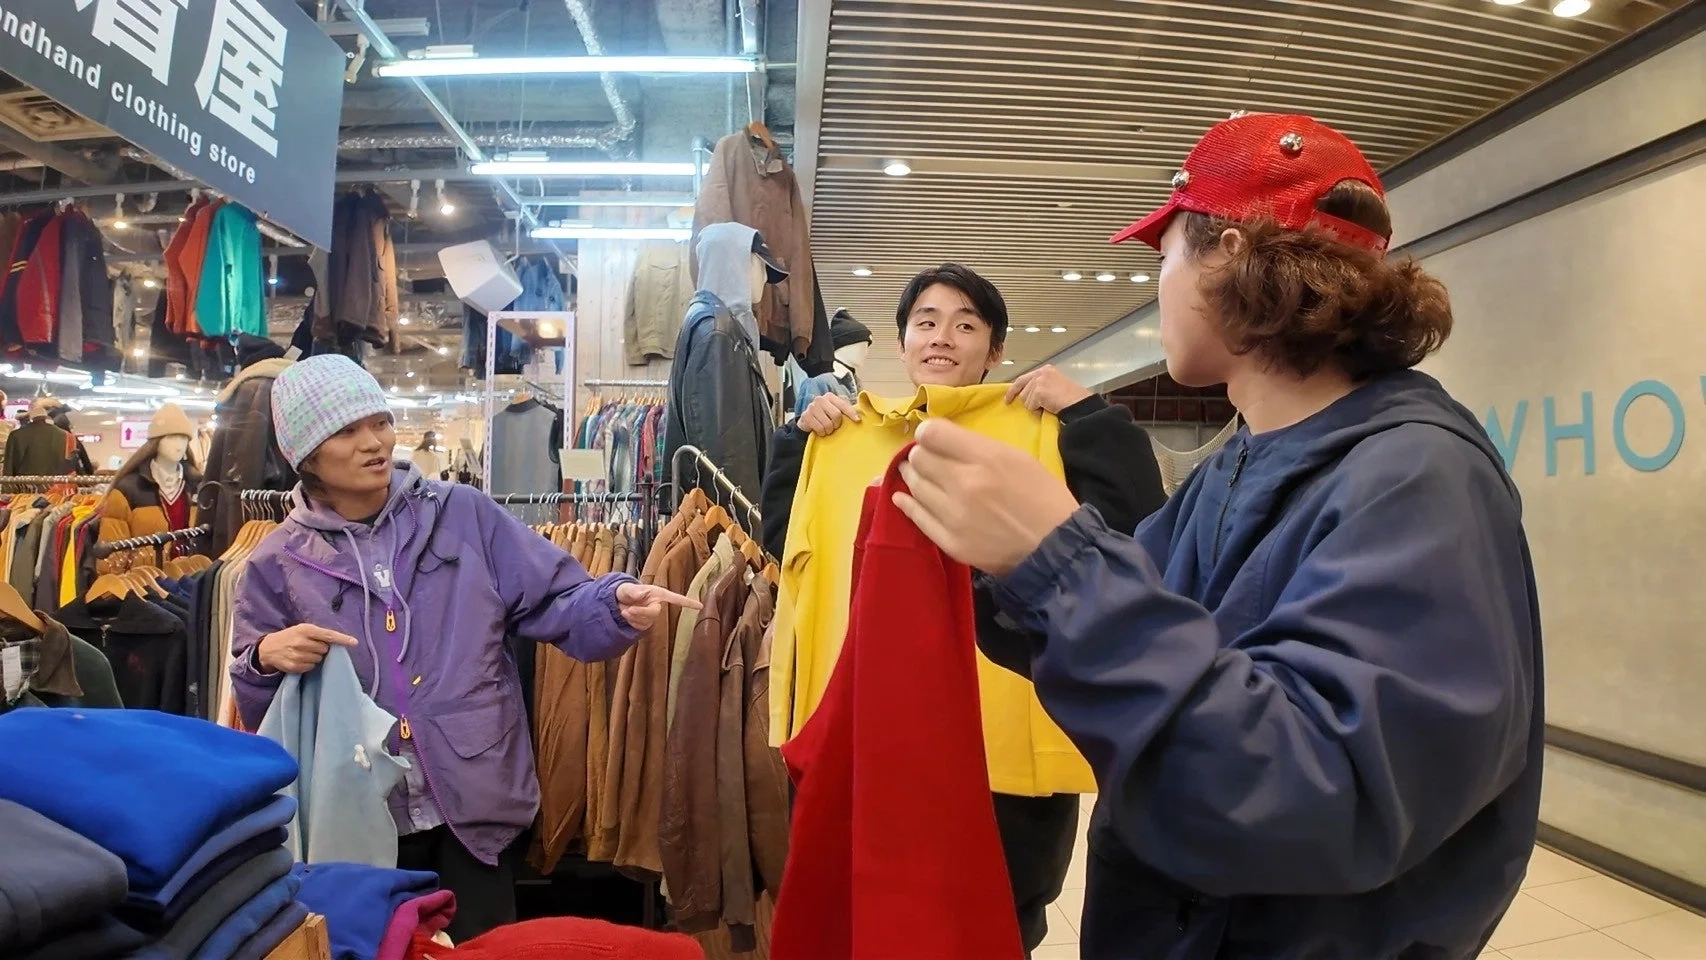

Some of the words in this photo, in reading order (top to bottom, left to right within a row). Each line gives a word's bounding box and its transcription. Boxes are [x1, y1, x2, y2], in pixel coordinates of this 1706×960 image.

[0, 6, 101, 90] ndhand
[111, 81, 202, 156] clothing
[209, 143, 256, 184] store
